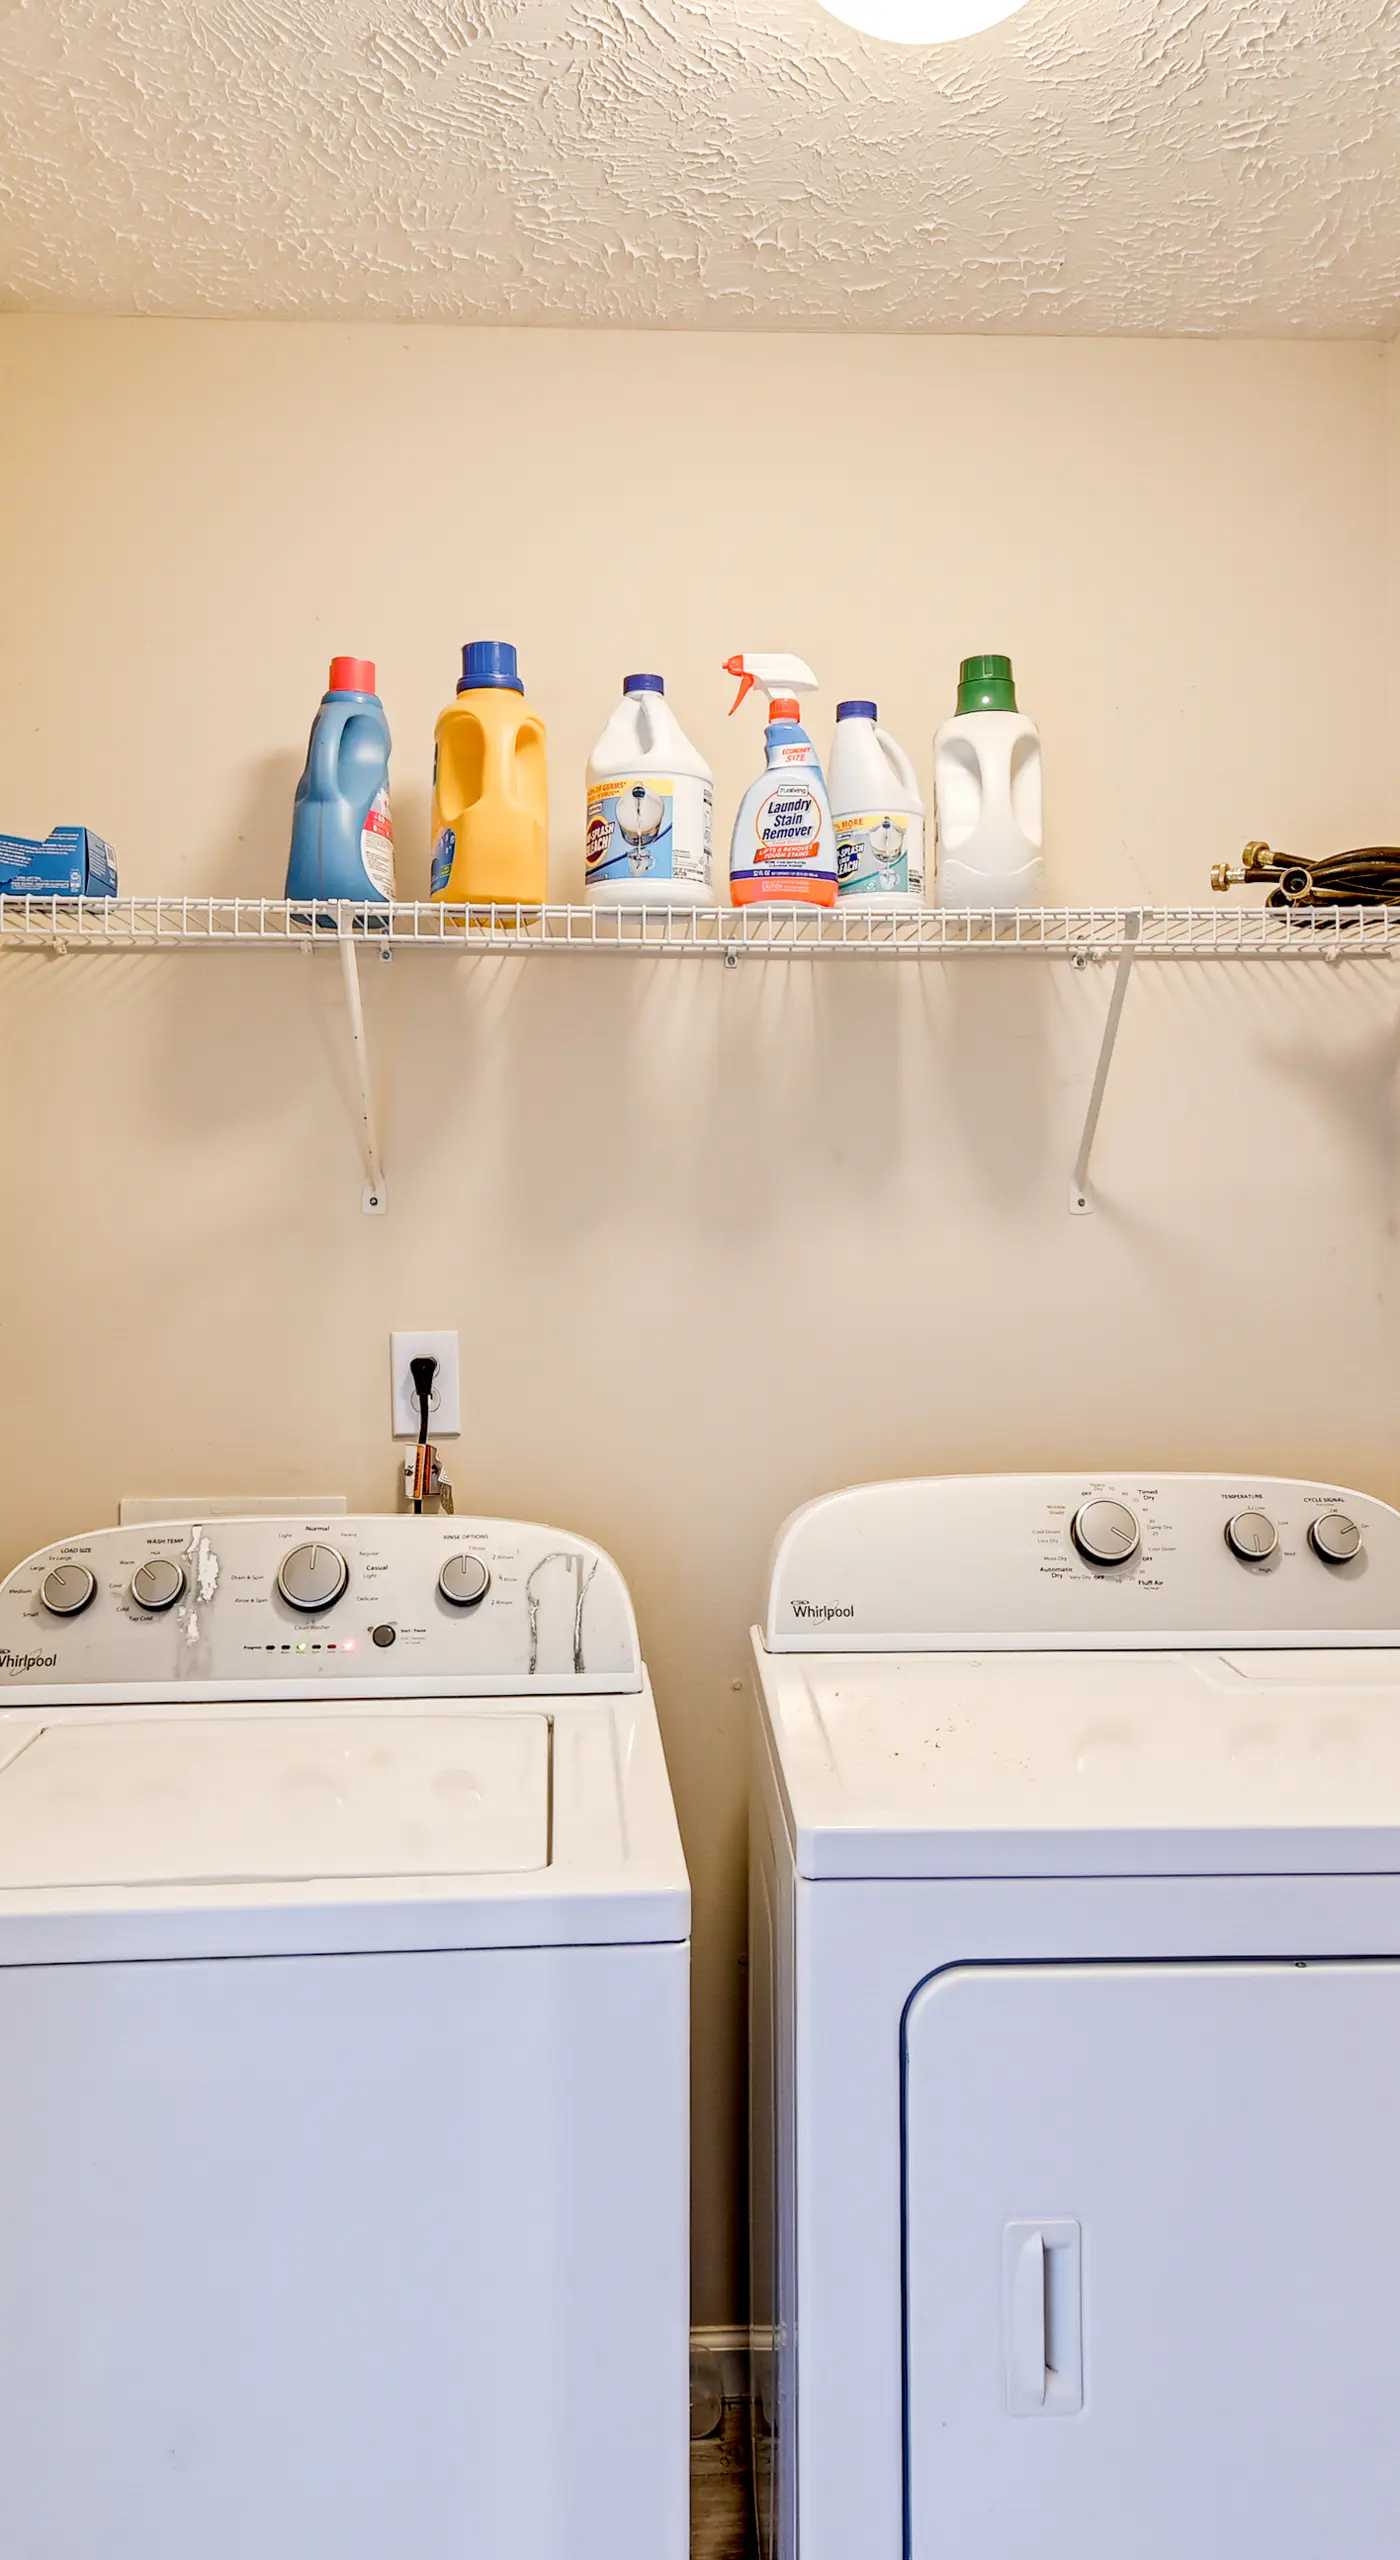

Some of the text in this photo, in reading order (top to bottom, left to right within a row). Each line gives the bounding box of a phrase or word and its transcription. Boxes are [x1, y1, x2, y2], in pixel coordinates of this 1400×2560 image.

[782, 747, 811, 755] ECONOMY
[786, 754, 806, 762] SIZE
[768, 798, 812, 814] Laundry
[774, 813, 802, 827] Stain
[842, 818, 864, 828] MORE
[588, 822, 614, 840] -SPLASH
[762, 826, 812, 840] Remover
[792, 1605, 854, 1620] Whirlpool
